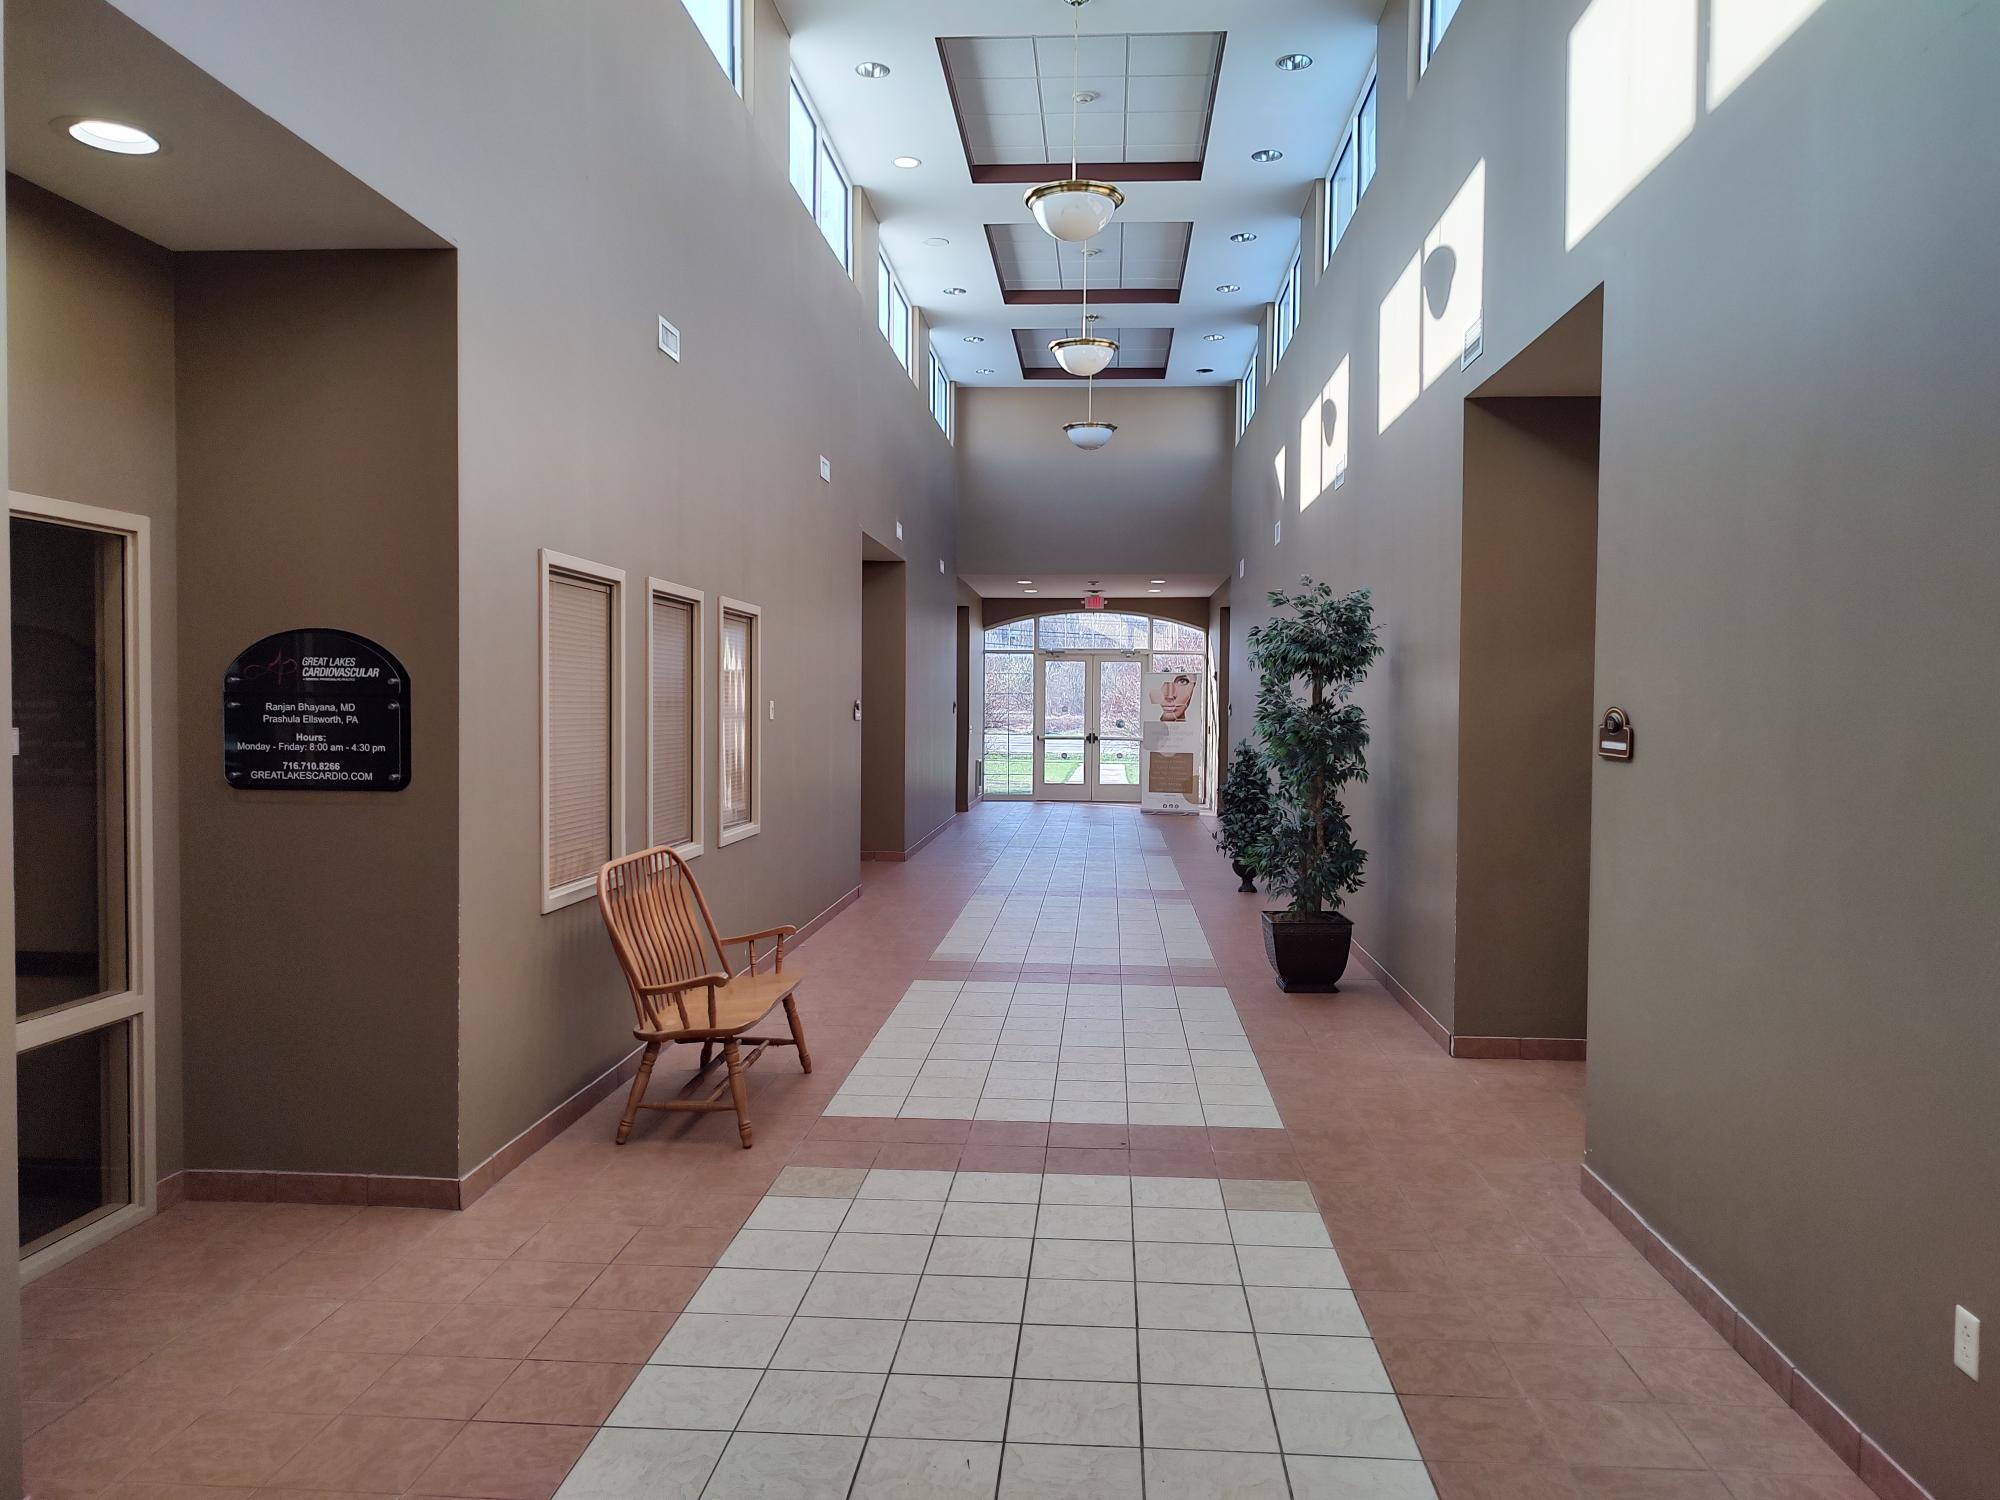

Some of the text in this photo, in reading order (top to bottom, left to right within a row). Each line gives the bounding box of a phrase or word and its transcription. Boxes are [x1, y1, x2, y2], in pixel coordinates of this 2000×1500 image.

[302, 657, 356, 666] GREAT LAKES
[302, 667, 380, 677] CARDIOVASCULAR
[265, 702, 356, 713] Ranjan Bhayana, MD
[262, 714, 359, 725] Prashula Ellsworth, PA
[296, 733, 326, 742] Hours:
[237, 742, 271, 752] Monday
[278, 742, 307, 753] Friday:
[309, 743, 328, 751] 8:00
[351, 743, 370, 752] 4:30
[372, 745, 386, 754] pm
[250, 771, 373, 781] GREATLAKESCARDIO.COM
